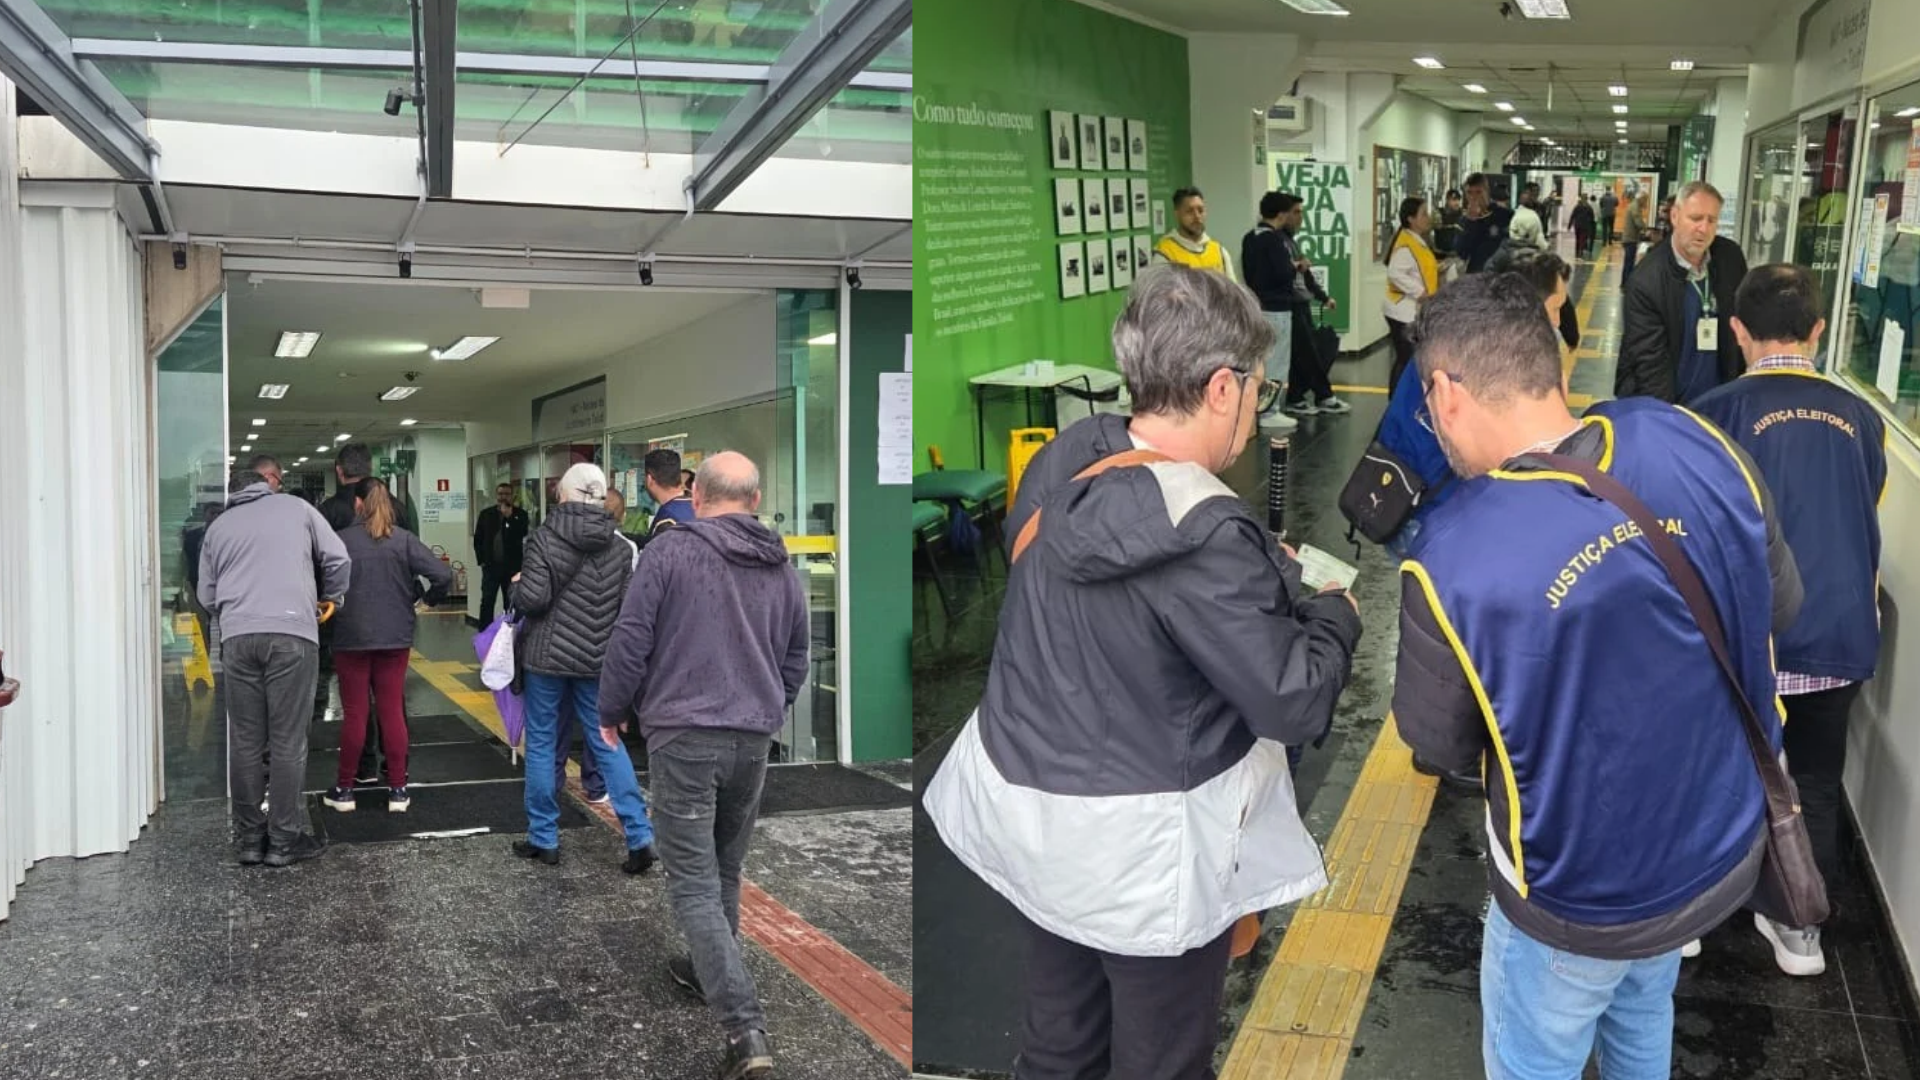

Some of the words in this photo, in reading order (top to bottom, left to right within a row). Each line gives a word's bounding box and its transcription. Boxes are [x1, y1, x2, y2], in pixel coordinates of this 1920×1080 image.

[913, 95, 954, 124] Como
[956, 102, 985, 127] tudo
[1276, 162, 1350, 188] VEJA
[1299, 211, 1350, 237] ALA
[1753, 409, 1795, 435] JUSTIÇA
[1796, 408, 1855, 438] ELEITORAL
[1545, 534, 1615, 610] JUSTIÇA
[1612, 517, 1688, 544] ELEAL
